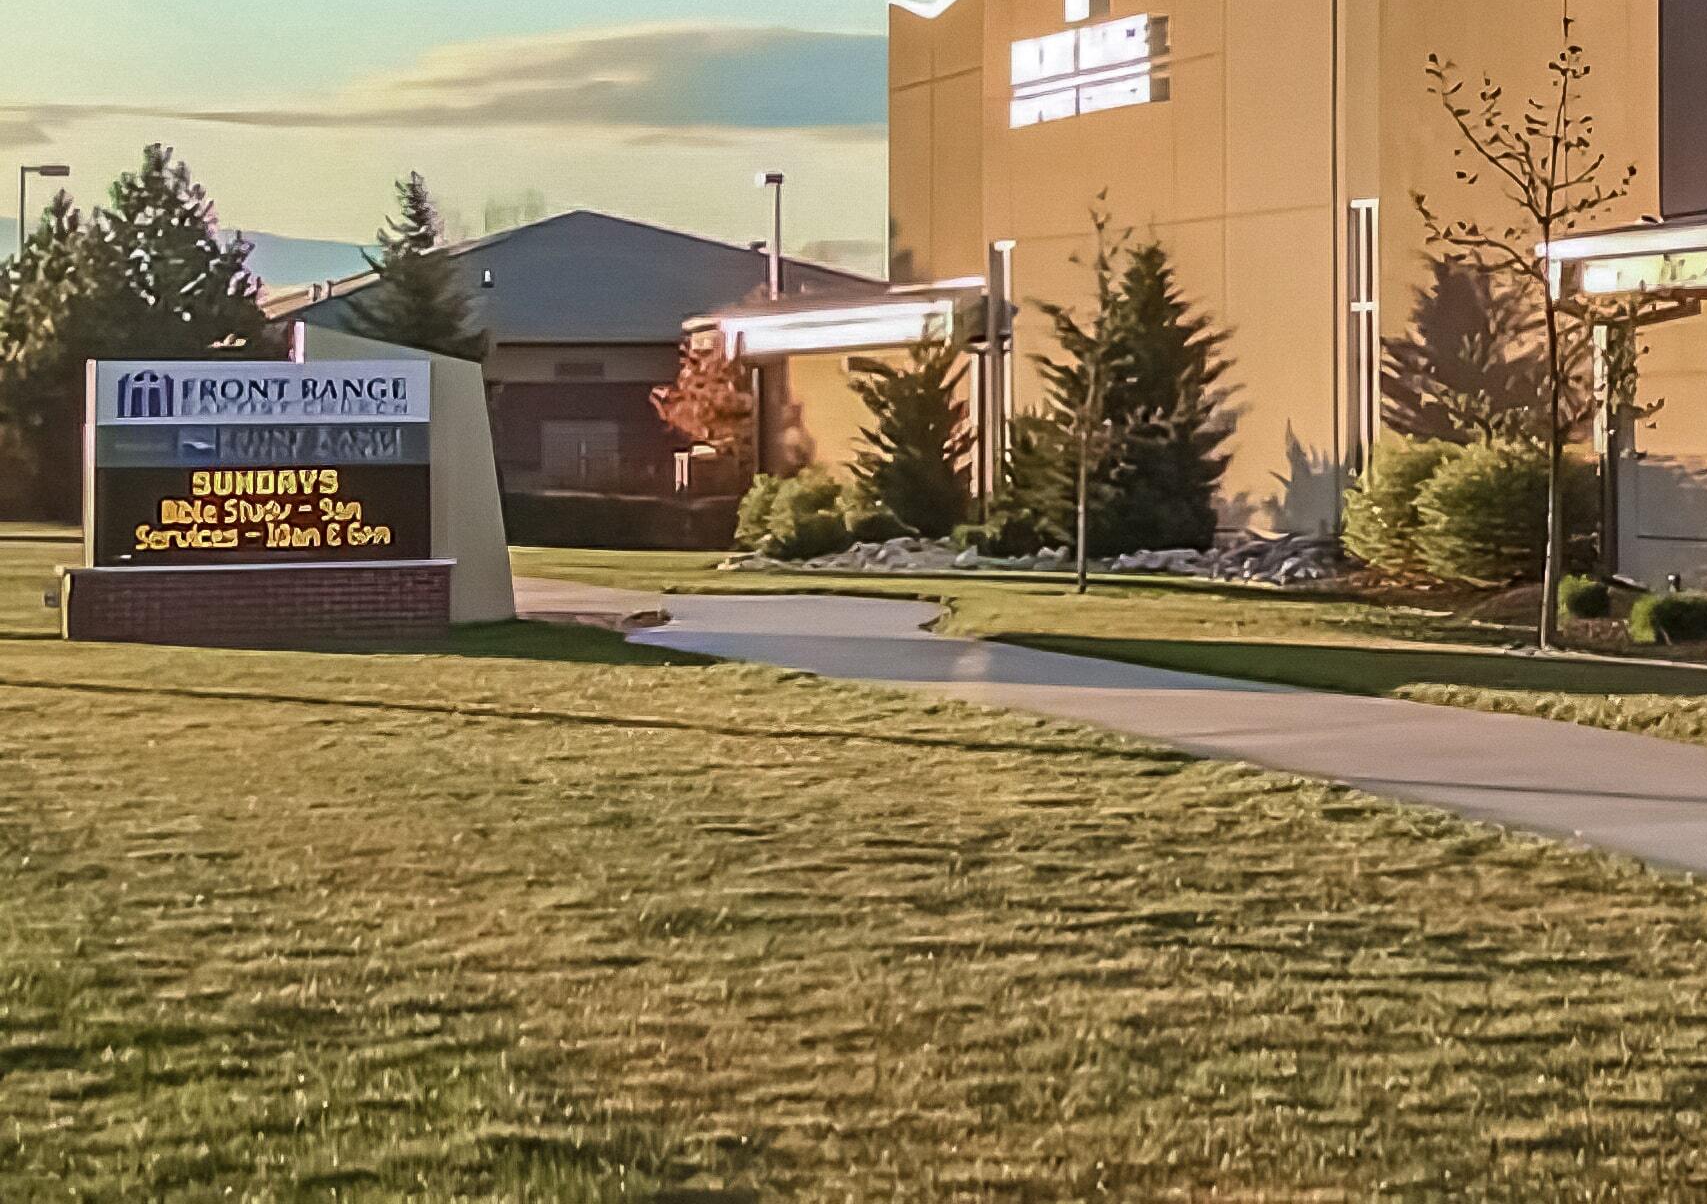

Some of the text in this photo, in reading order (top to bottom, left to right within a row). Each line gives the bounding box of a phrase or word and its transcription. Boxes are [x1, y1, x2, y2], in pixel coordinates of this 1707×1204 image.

[181, 377, 408, 401] FRONT RANGE
[192, 469, 339, 495] SUNDAYS
[135, 524, 239, 550] Services
